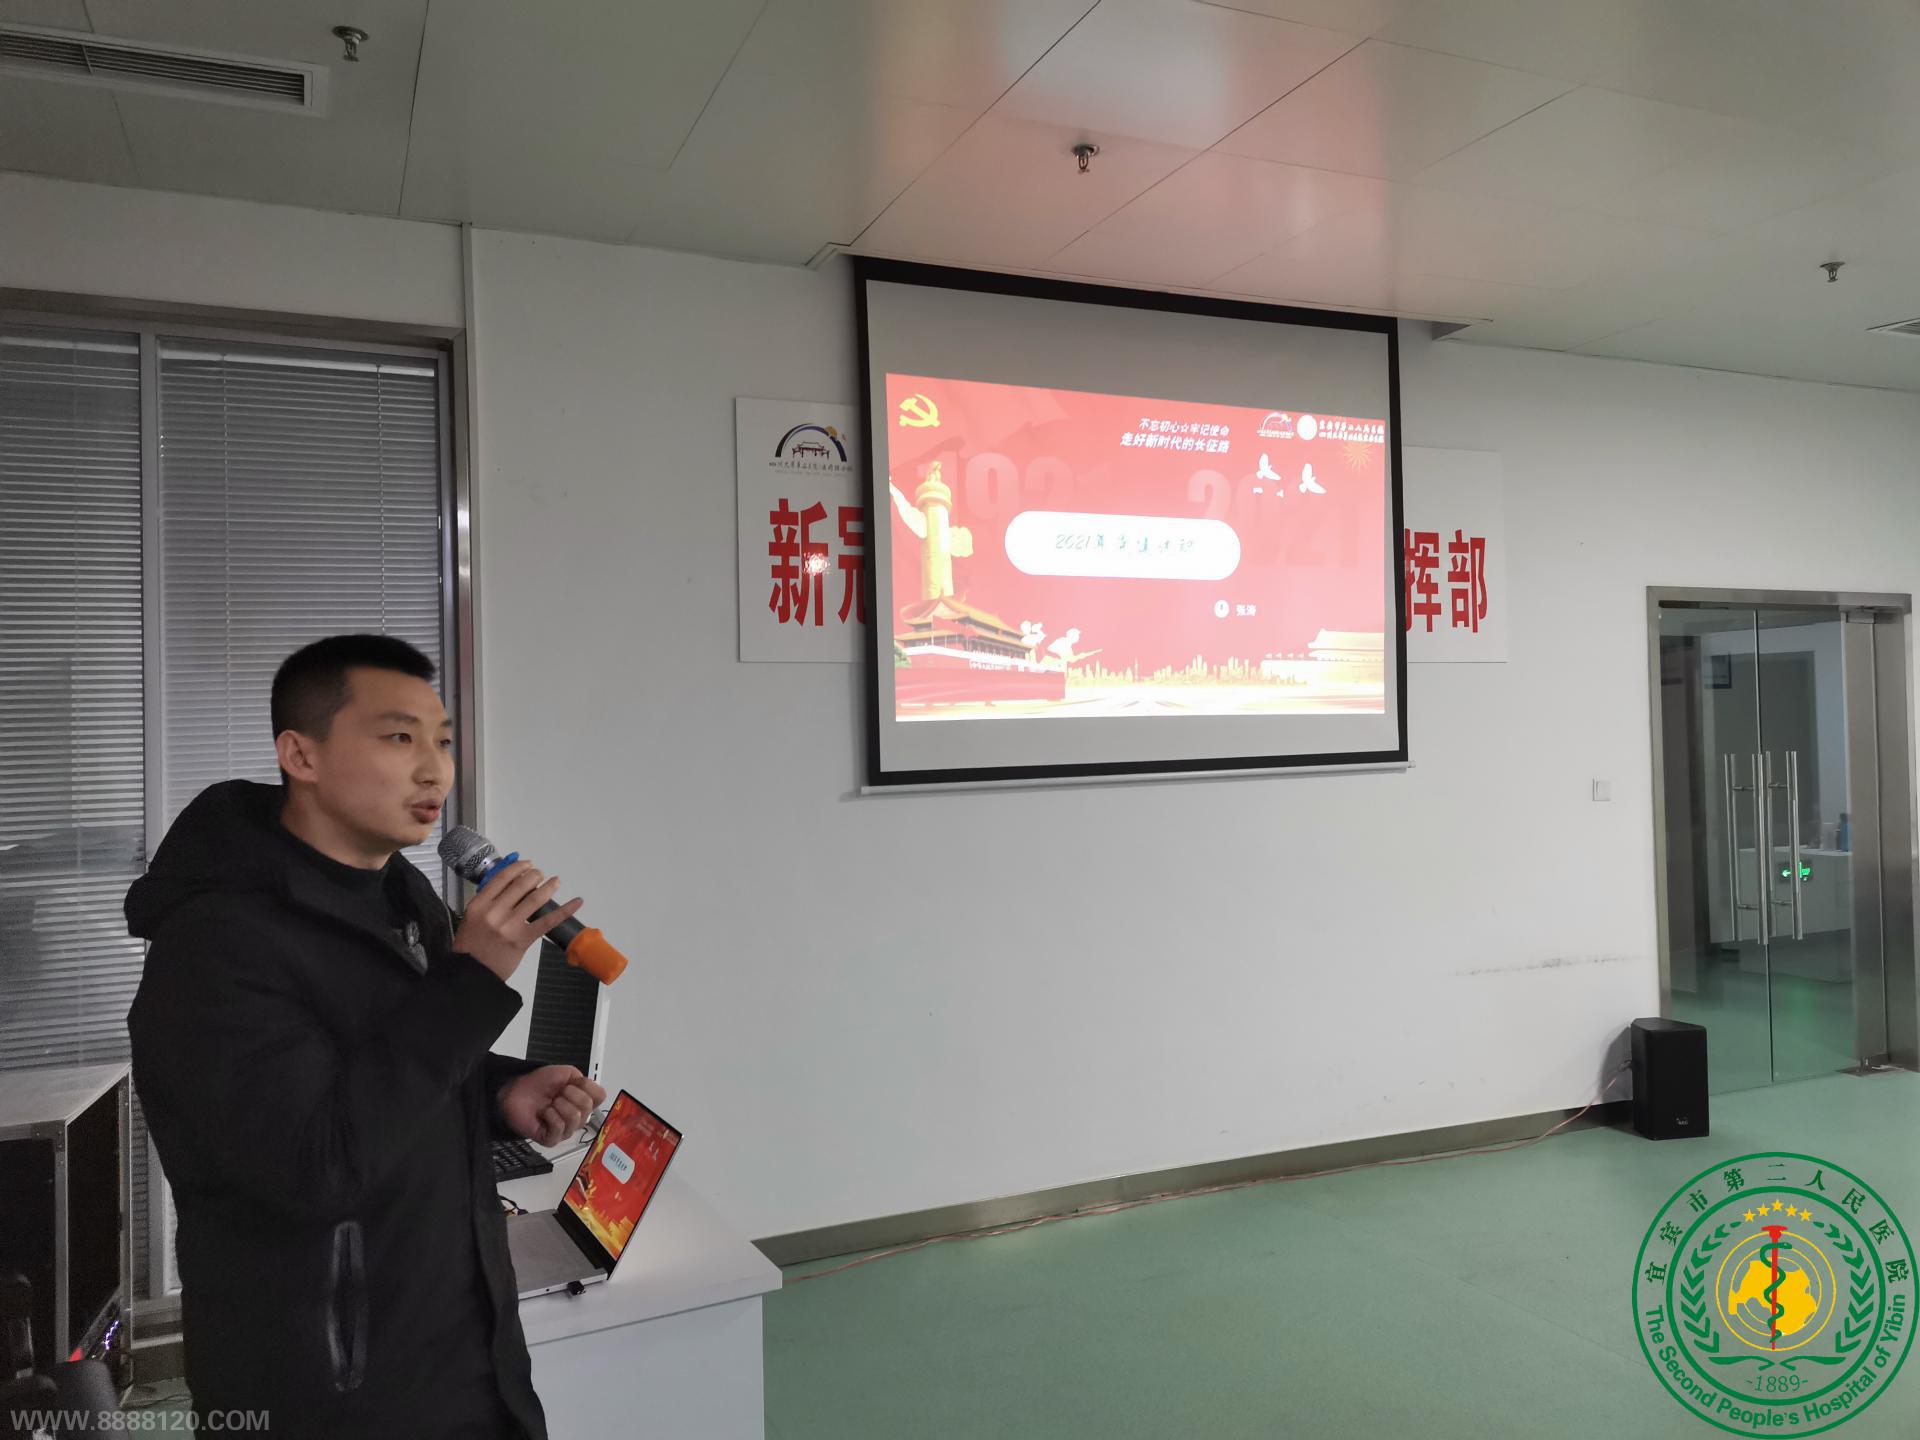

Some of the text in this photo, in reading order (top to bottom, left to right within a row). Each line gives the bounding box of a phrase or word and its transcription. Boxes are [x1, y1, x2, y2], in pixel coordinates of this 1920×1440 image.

[1120, 432, 1230, 453] 走好新时代的长征路
[1404, 528, 1487, 633] 挥部
